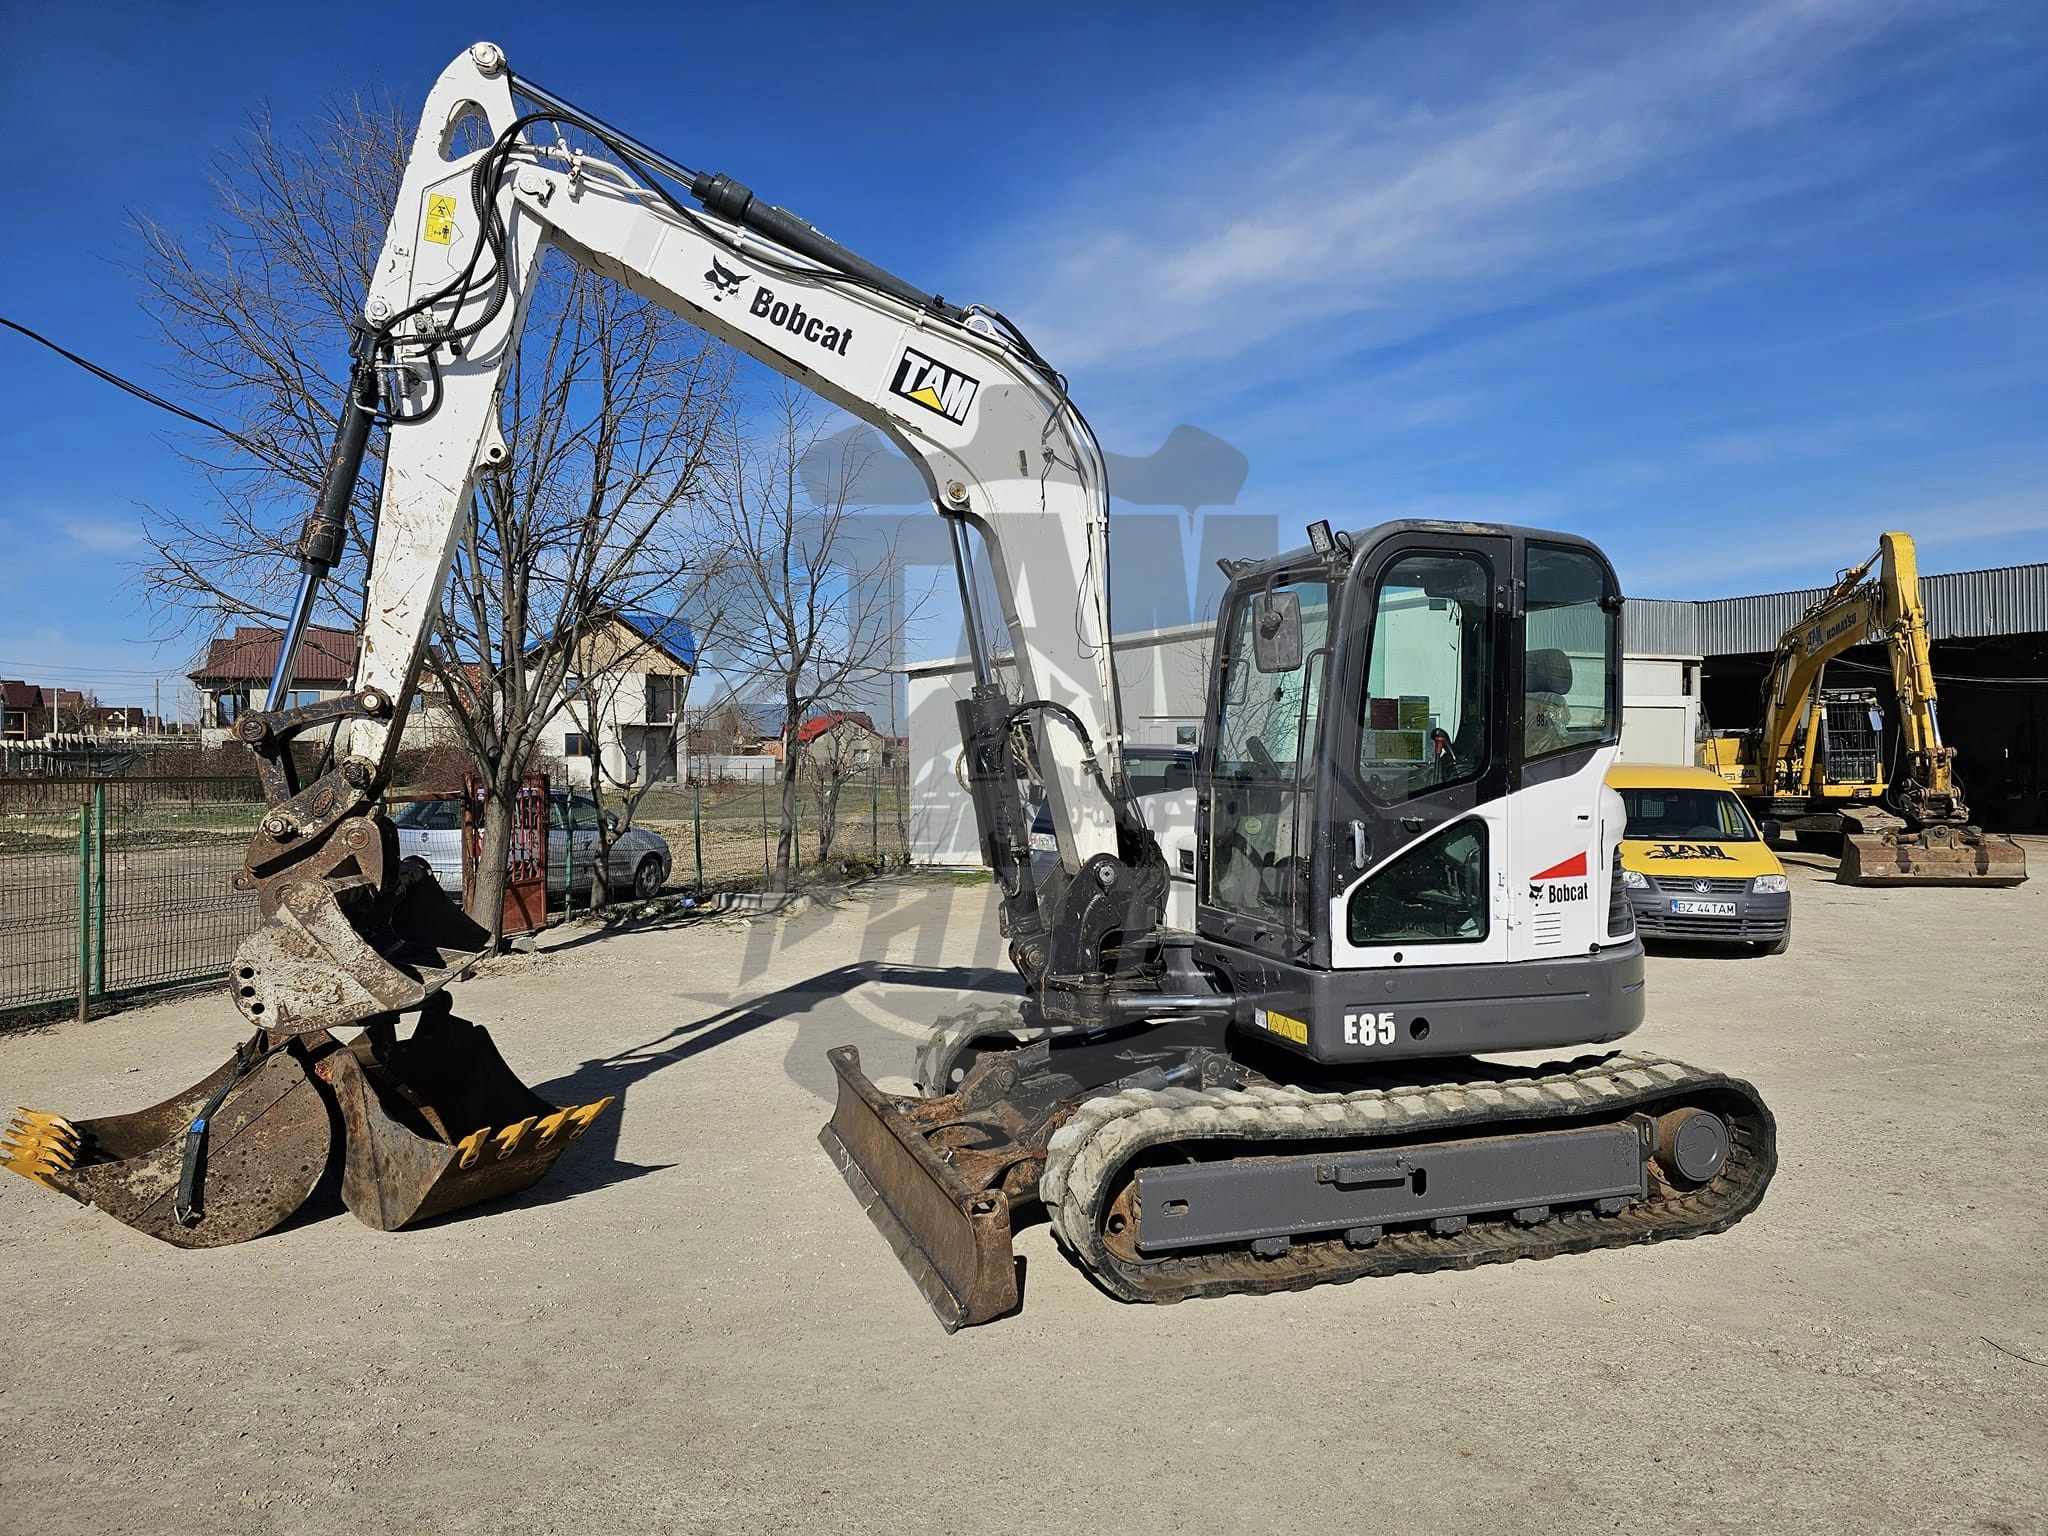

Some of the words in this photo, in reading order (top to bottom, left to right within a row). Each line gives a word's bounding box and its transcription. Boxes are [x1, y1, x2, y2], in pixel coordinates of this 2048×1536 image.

[749, 285, 853, 357] Bobcat
[899, 351, 977, 423] TAM
[1653, 844, 1727, 860] TAM
[1548, 882, 1588, 903] Bobcat
[1678, 903, 1693, 913] BZ
[1343, 1012, 1397, 1047] E85
